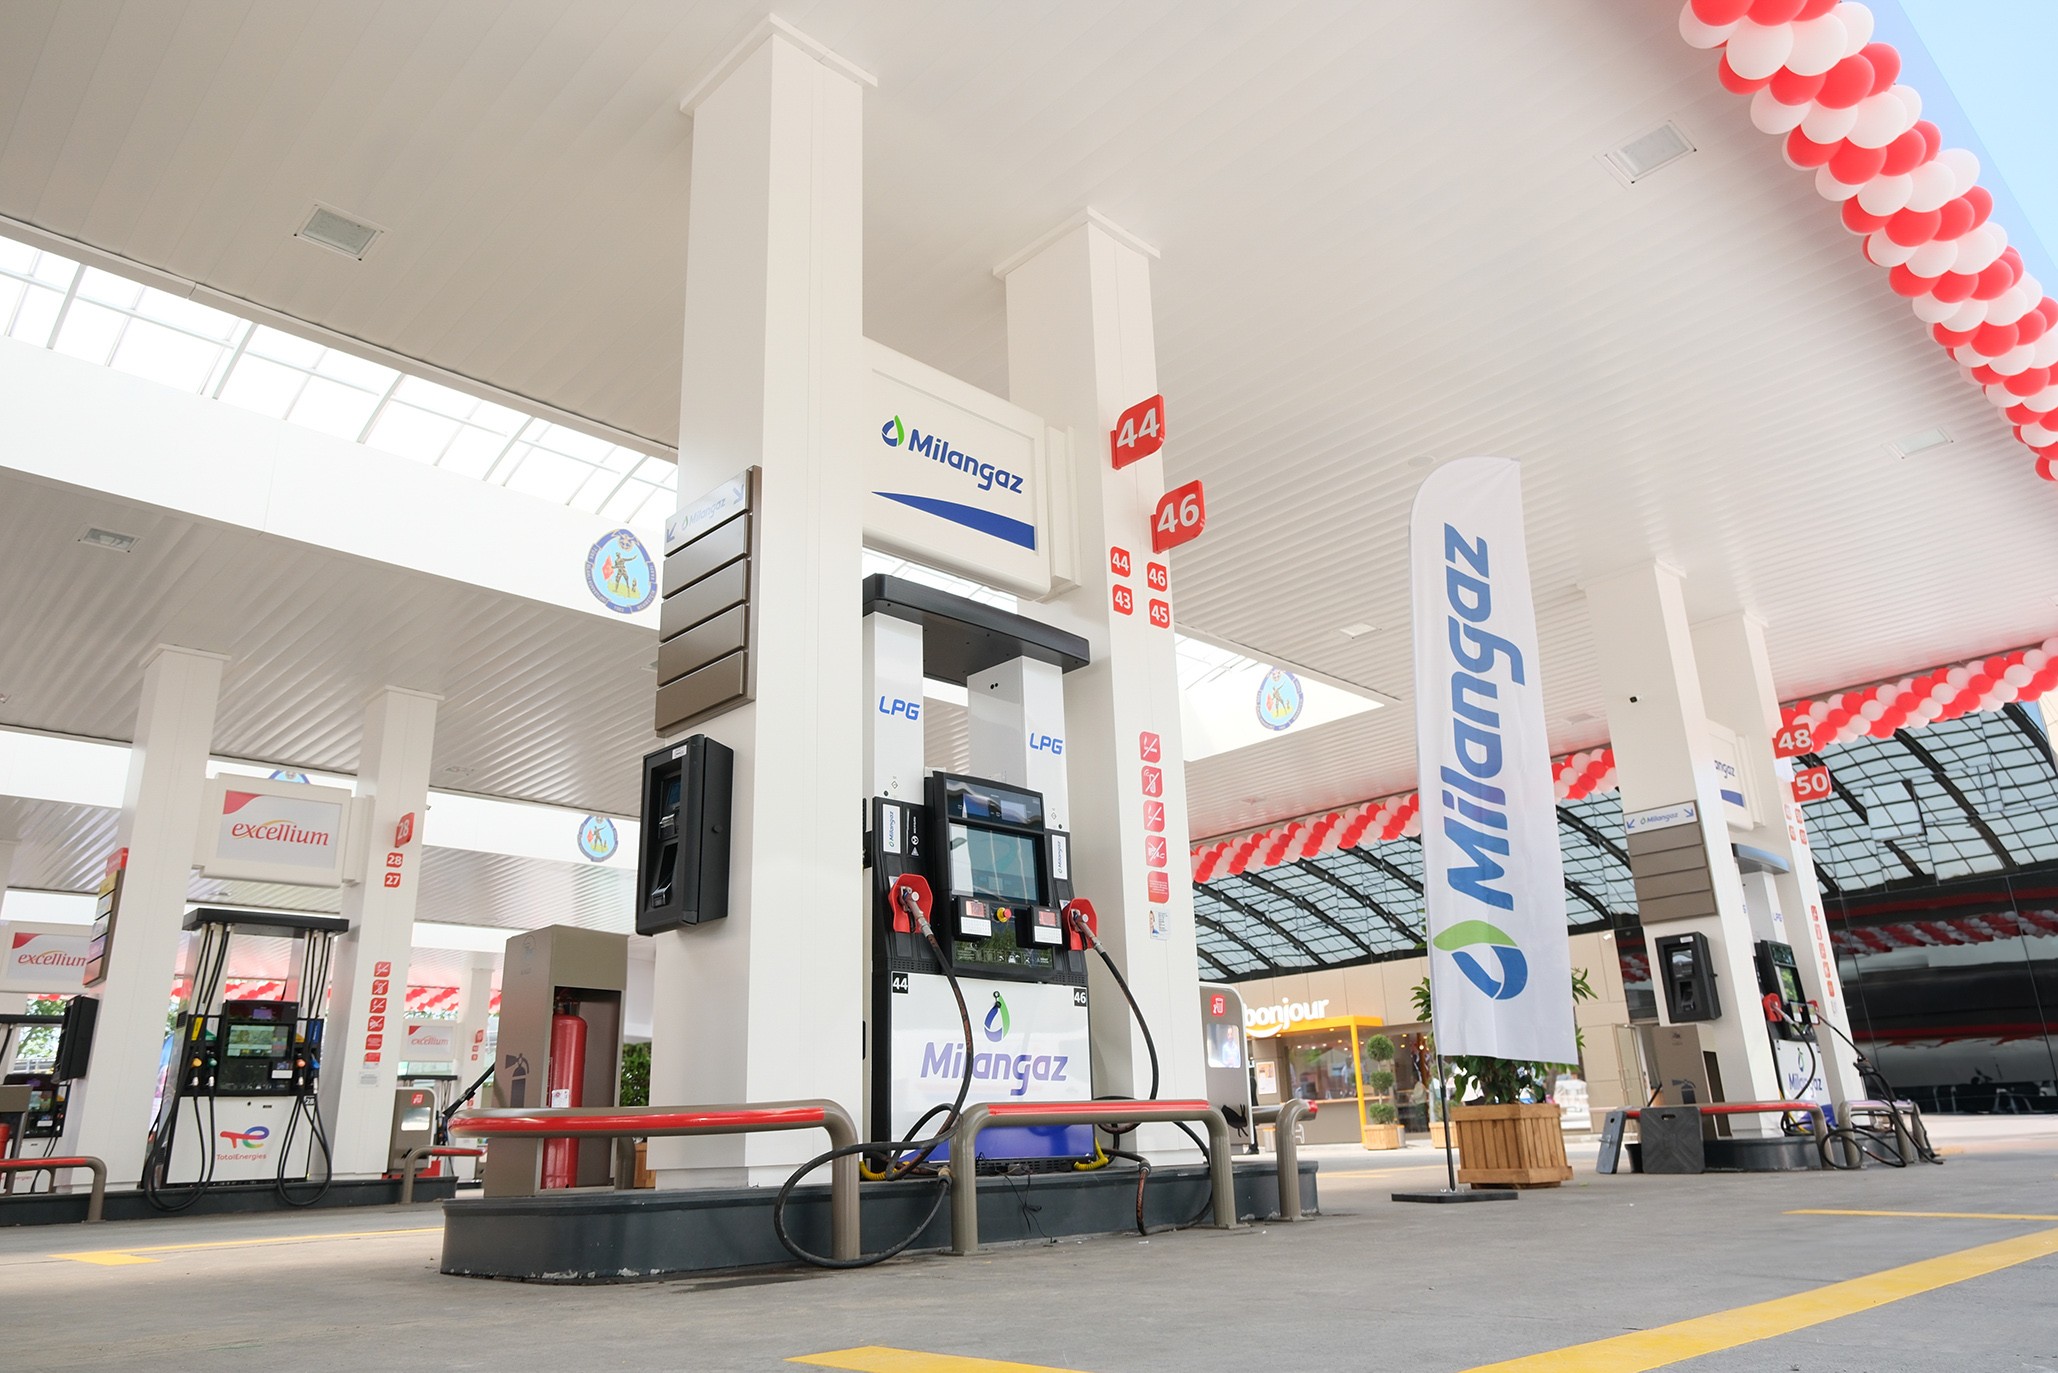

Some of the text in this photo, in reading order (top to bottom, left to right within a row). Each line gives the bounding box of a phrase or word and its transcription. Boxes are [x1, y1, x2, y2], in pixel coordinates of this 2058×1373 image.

[1116, 408, 1160, 448] 44
[907, 429, 1024, 494] Milangaz
[689, 498, 726, 525] Milangaz
[1157, 493, 1200, 533] 46
[1111, 552, 1129, 572] 44
[1148, 567, 1166, 588] 46
[1114, 590, 1131, 610] 43
[1150, 604, 1169, 623] 45
[878, 695, 921, 721] LPG
[1440, 522, 1526, 912] Milangaz
[1029, 732, 1064, 755] LPG
[1778, 728, 1811, 750] 48
[1796, 773, 1828, 795] 50
[1647, 812, 1679, 823] Milangaz
[231, 821, 329, 846] excellium
[397, 819, 410, 840] 28
[388, 855, 402, 866] 28
[386, 875, 400, 885] 27
[892, 976, 908, 991] 44
[1074, 991, 1087, 1004] 46
[1244, 997, 1329, 1030] bonjour
[920, 1041, 1069, 1096] Miangaz
[217, 1153, 267, 1161] TotalEnergies
